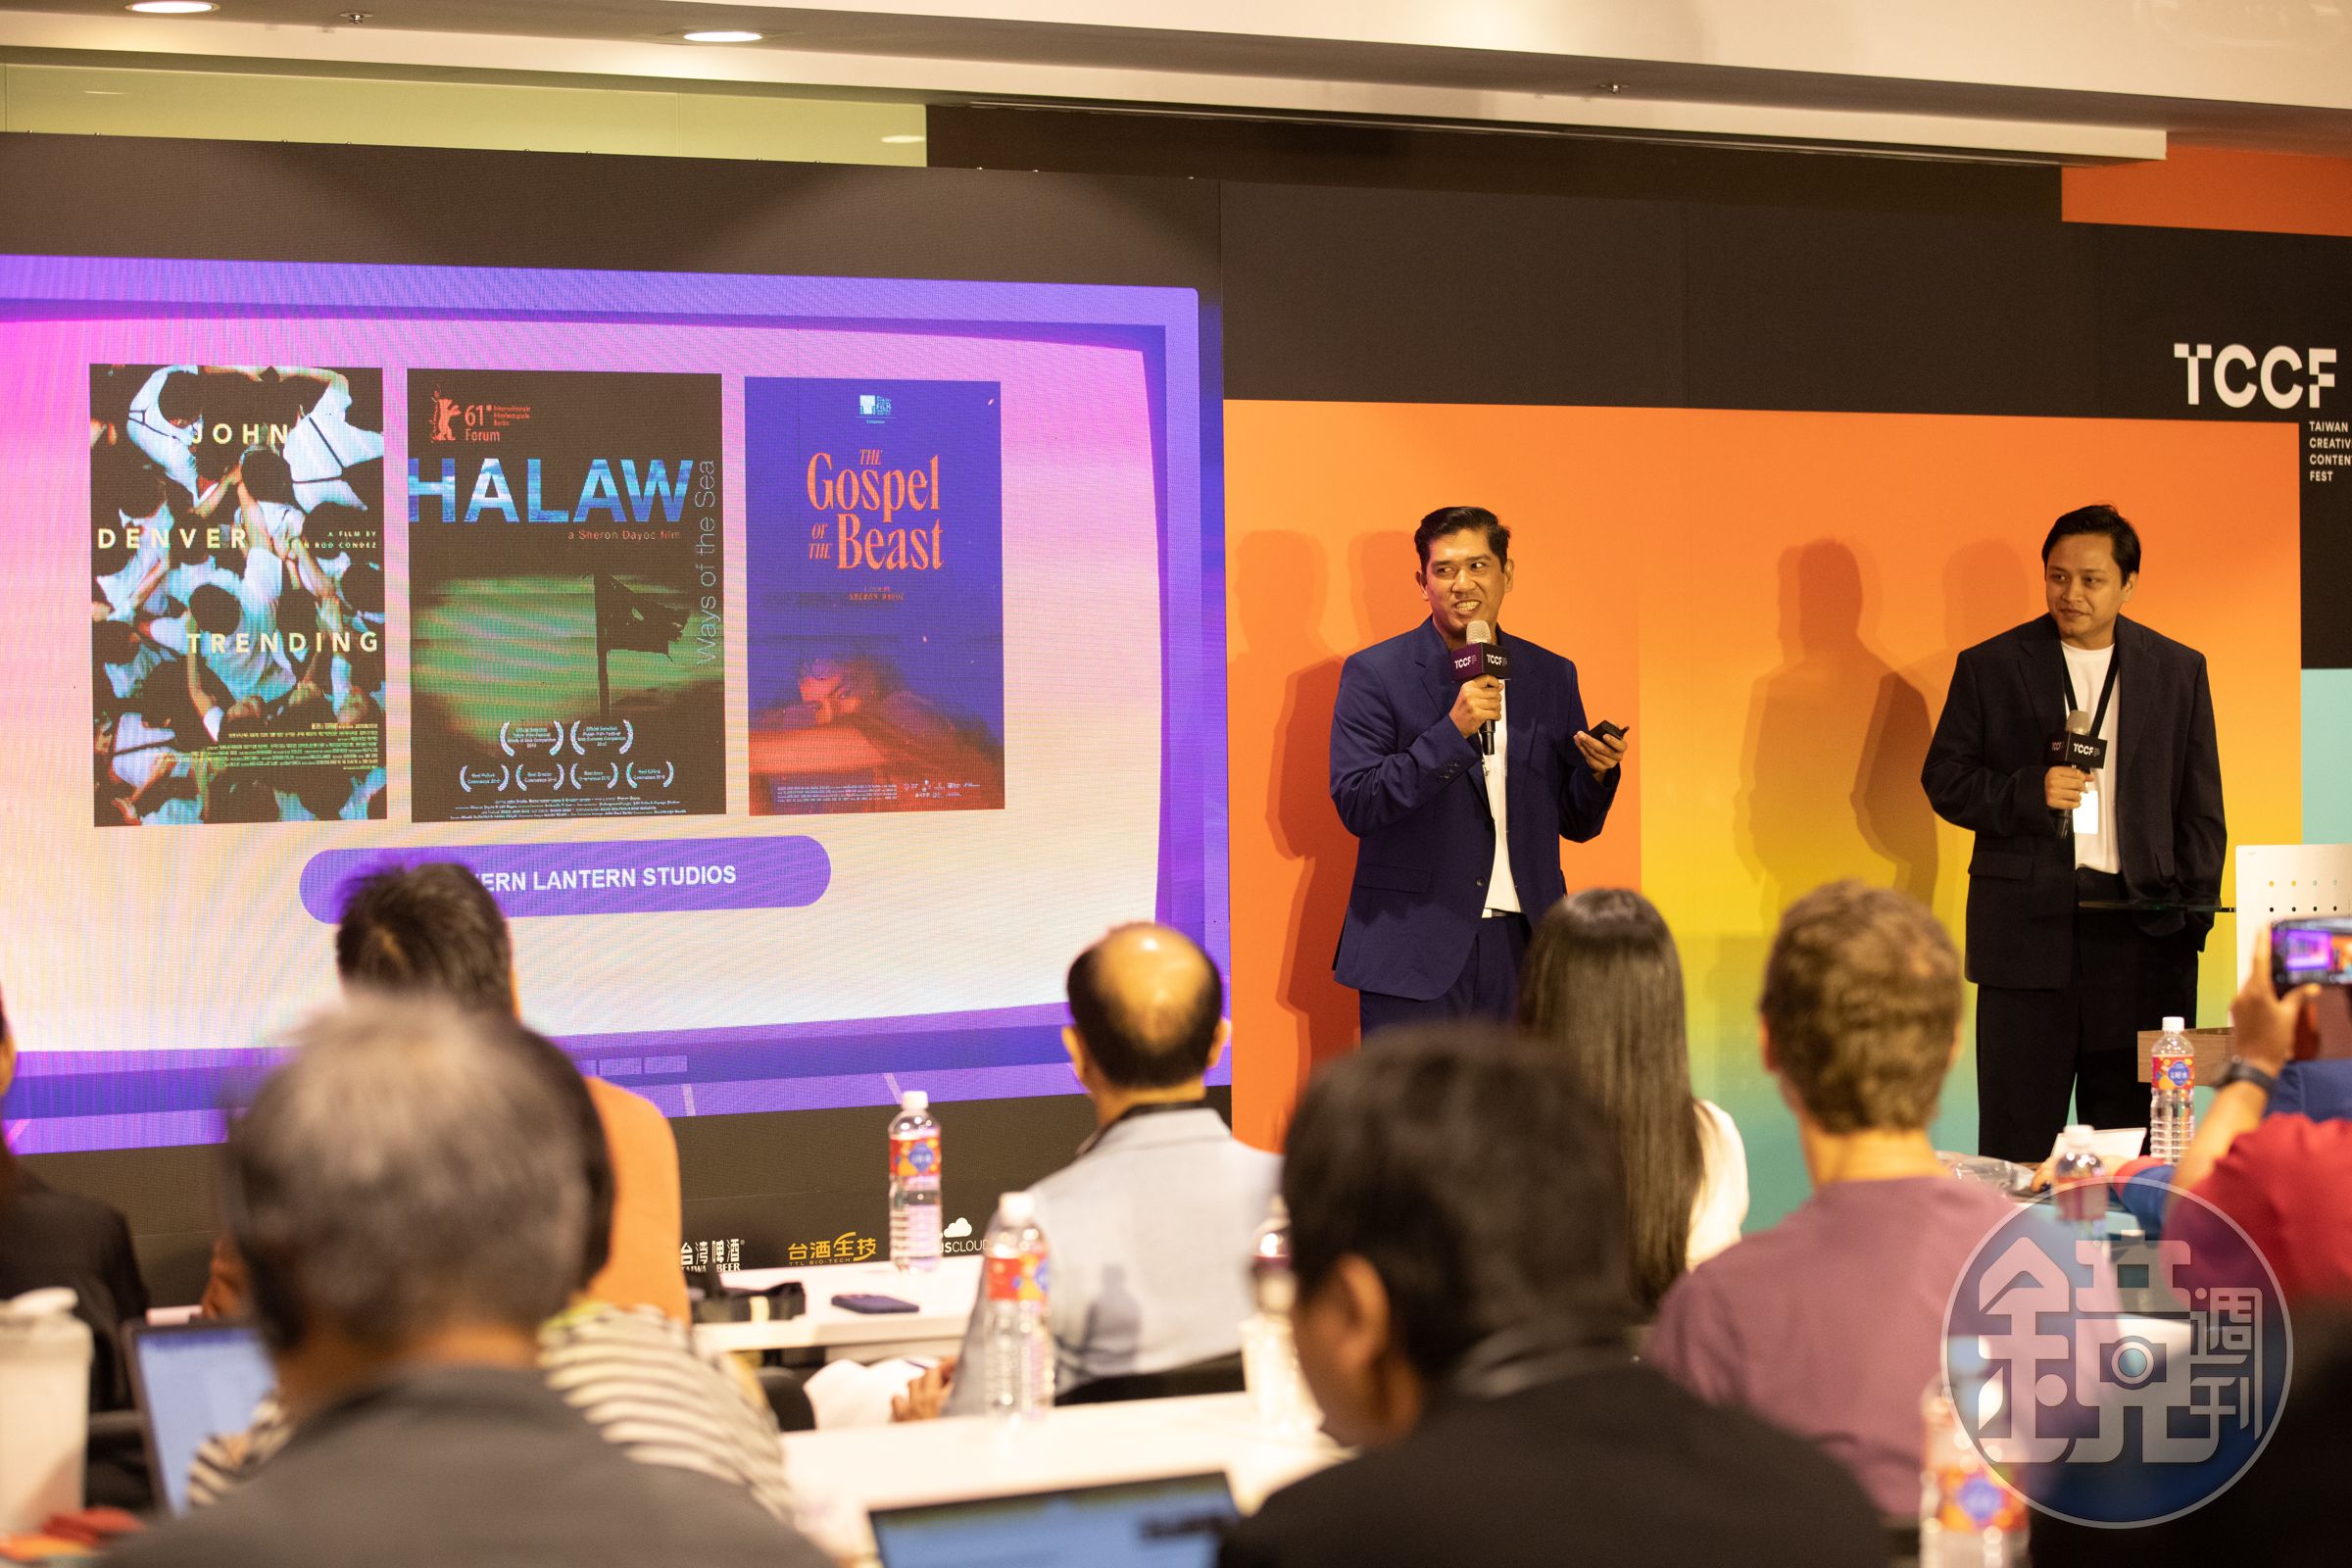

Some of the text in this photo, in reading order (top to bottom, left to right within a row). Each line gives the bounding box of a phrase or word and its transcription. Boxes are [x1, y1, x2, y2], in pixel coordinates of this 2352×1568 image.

[2174, 343, 2337, 410] TCCF
[191, 423, 289, 445] JOHN
[466, 428, 501, 442] Forum
[2309, 420, 2349, 433] TAIWAN
[2309, 437, 2352, 449] CREATIV
[858, 449, 882, 466] THE
[2309, 454, 2352, 466] CONTEN
[2310, 470, 2333, 482] FEST
[408, 458, 694, 522] HALAW
[807, 452, 940, 523] Gospel
[98, 527, 247, 550] DENVER
[837, 513, 945, 570] Beast
[808, 543, 831, 560] THE
[694, 460, 721, 665] Ways of the Sea
[186, 631, 378, 653] TRENDING
[2073, 743, 2094, 756] TCCF
[474, 865, 737, 892] ERN LANTERN STUDIOS
[716, 1262, 741, 1273] BEER
